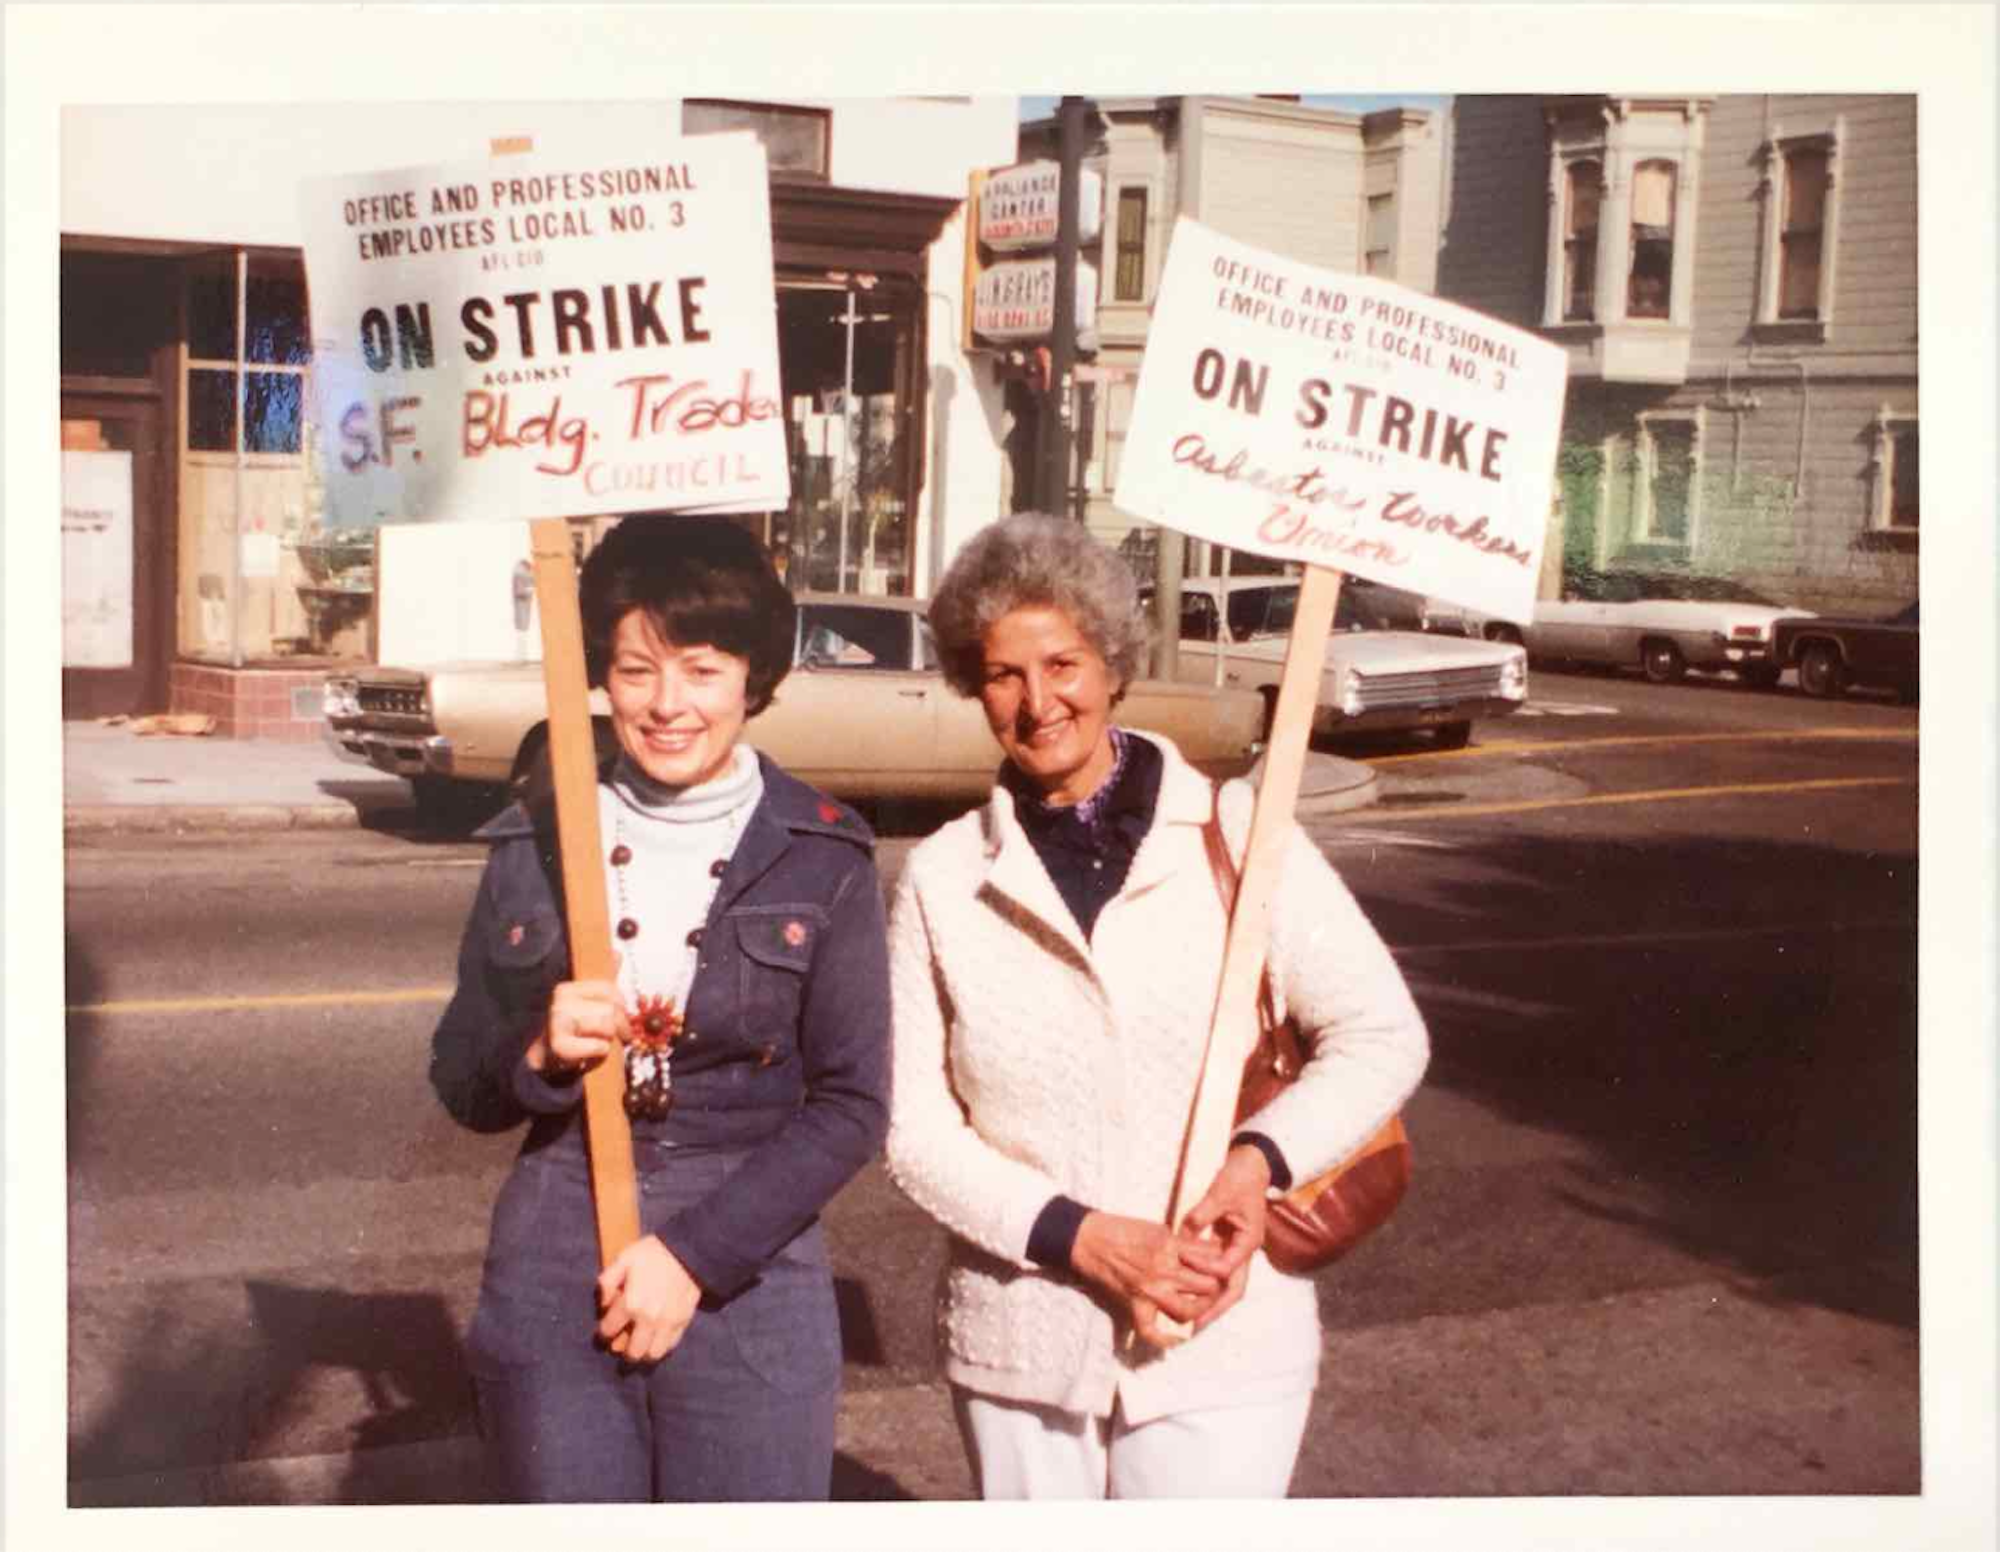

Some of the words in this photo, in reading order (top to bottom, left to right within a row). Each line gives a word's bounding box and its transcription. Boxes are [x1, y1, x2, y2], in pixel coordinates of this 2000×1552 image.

[344, 192, 417, 226] OFFICE
[432, 183, 479, 215] AND
[491, 163, 698, 209] PROFESSIONAL
[358, 217, 496, 261] EMPLOYEES
[509, 208, 593, 243] LOCAL
[609, 204, 655, 233] NO.
[669, 200, 685, 227] 3
[360, 301, 435, 373] ON
[460, 277, 711, 364] STRIKE
[1213, 255, 1288, 299] OFFICE
[1300, 285, 1348, 314] AND
[1361, 297, 1521, 369] PROFESSIONAL
[1217, 287, 1356, 342] EMPLOYEES
[1367, 325, 1434, 368] LOCAL
[1448, 353, 1481, 385] NO.
[1493, 369, 1507, 391] 3
[483, 366, 571, 386] AGAINST
[1192, 347, 1271, 416] ON
[1295, 377, 1509, 483] STRIKE
[340, 396, 423, 473] S.F.
